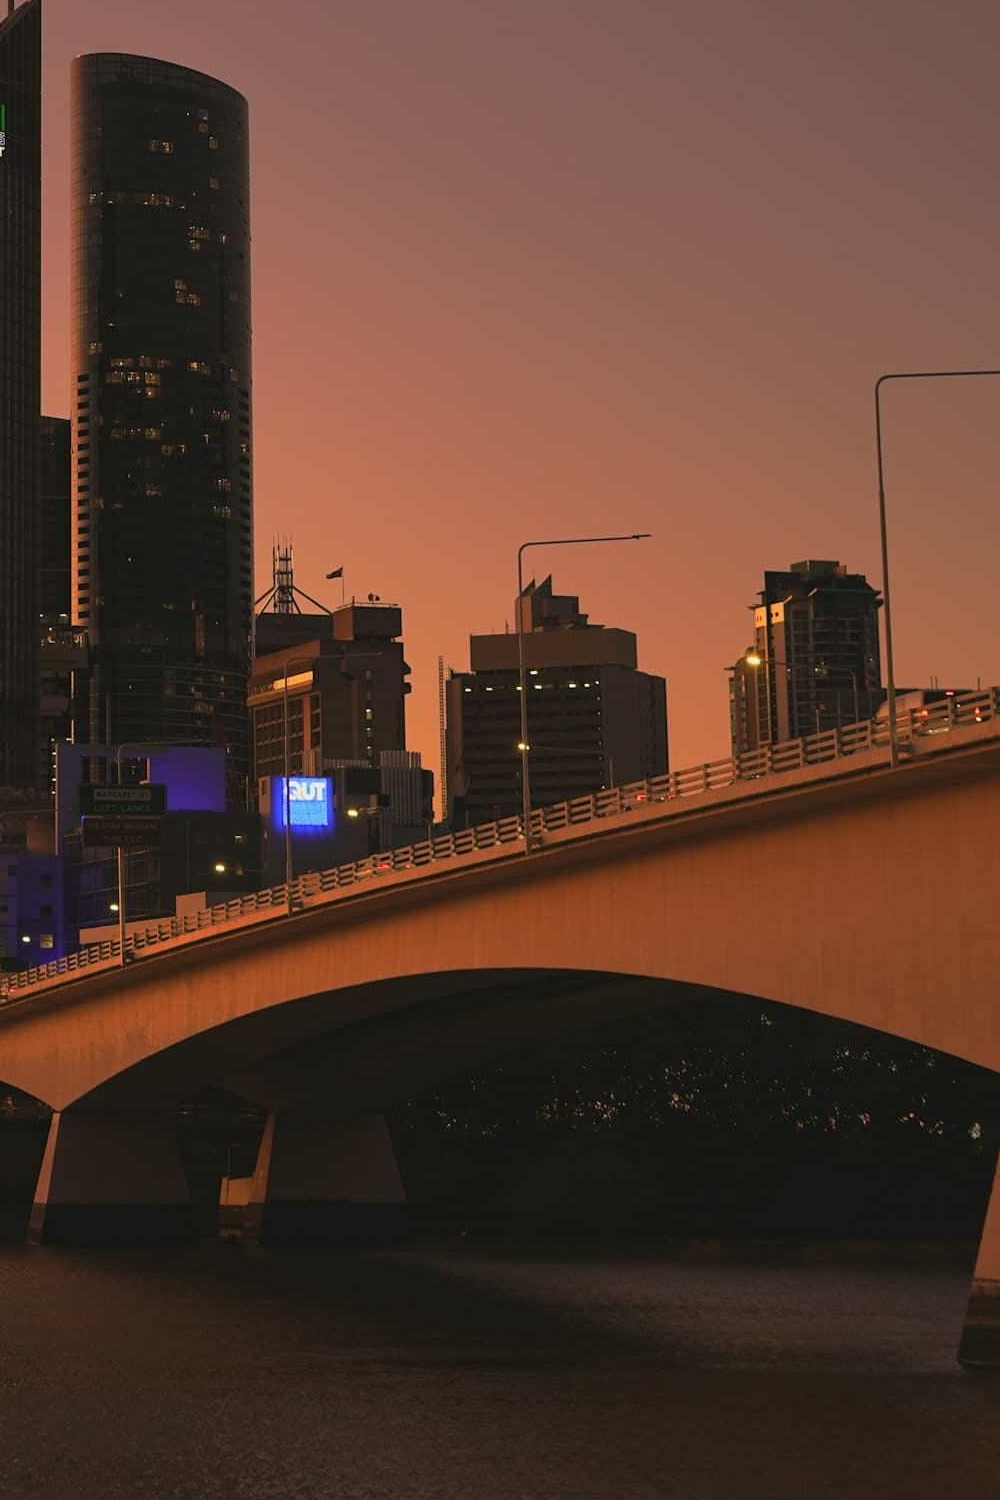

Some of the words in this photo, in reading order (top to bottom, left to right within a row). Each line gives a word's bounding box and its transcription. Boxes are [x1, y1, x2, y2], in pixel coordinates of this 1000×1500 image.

[95, 790, 136, 798] MARGARET
[284, 781, 326, 801] QUT
[94, 804, 116, 812] LEFT
